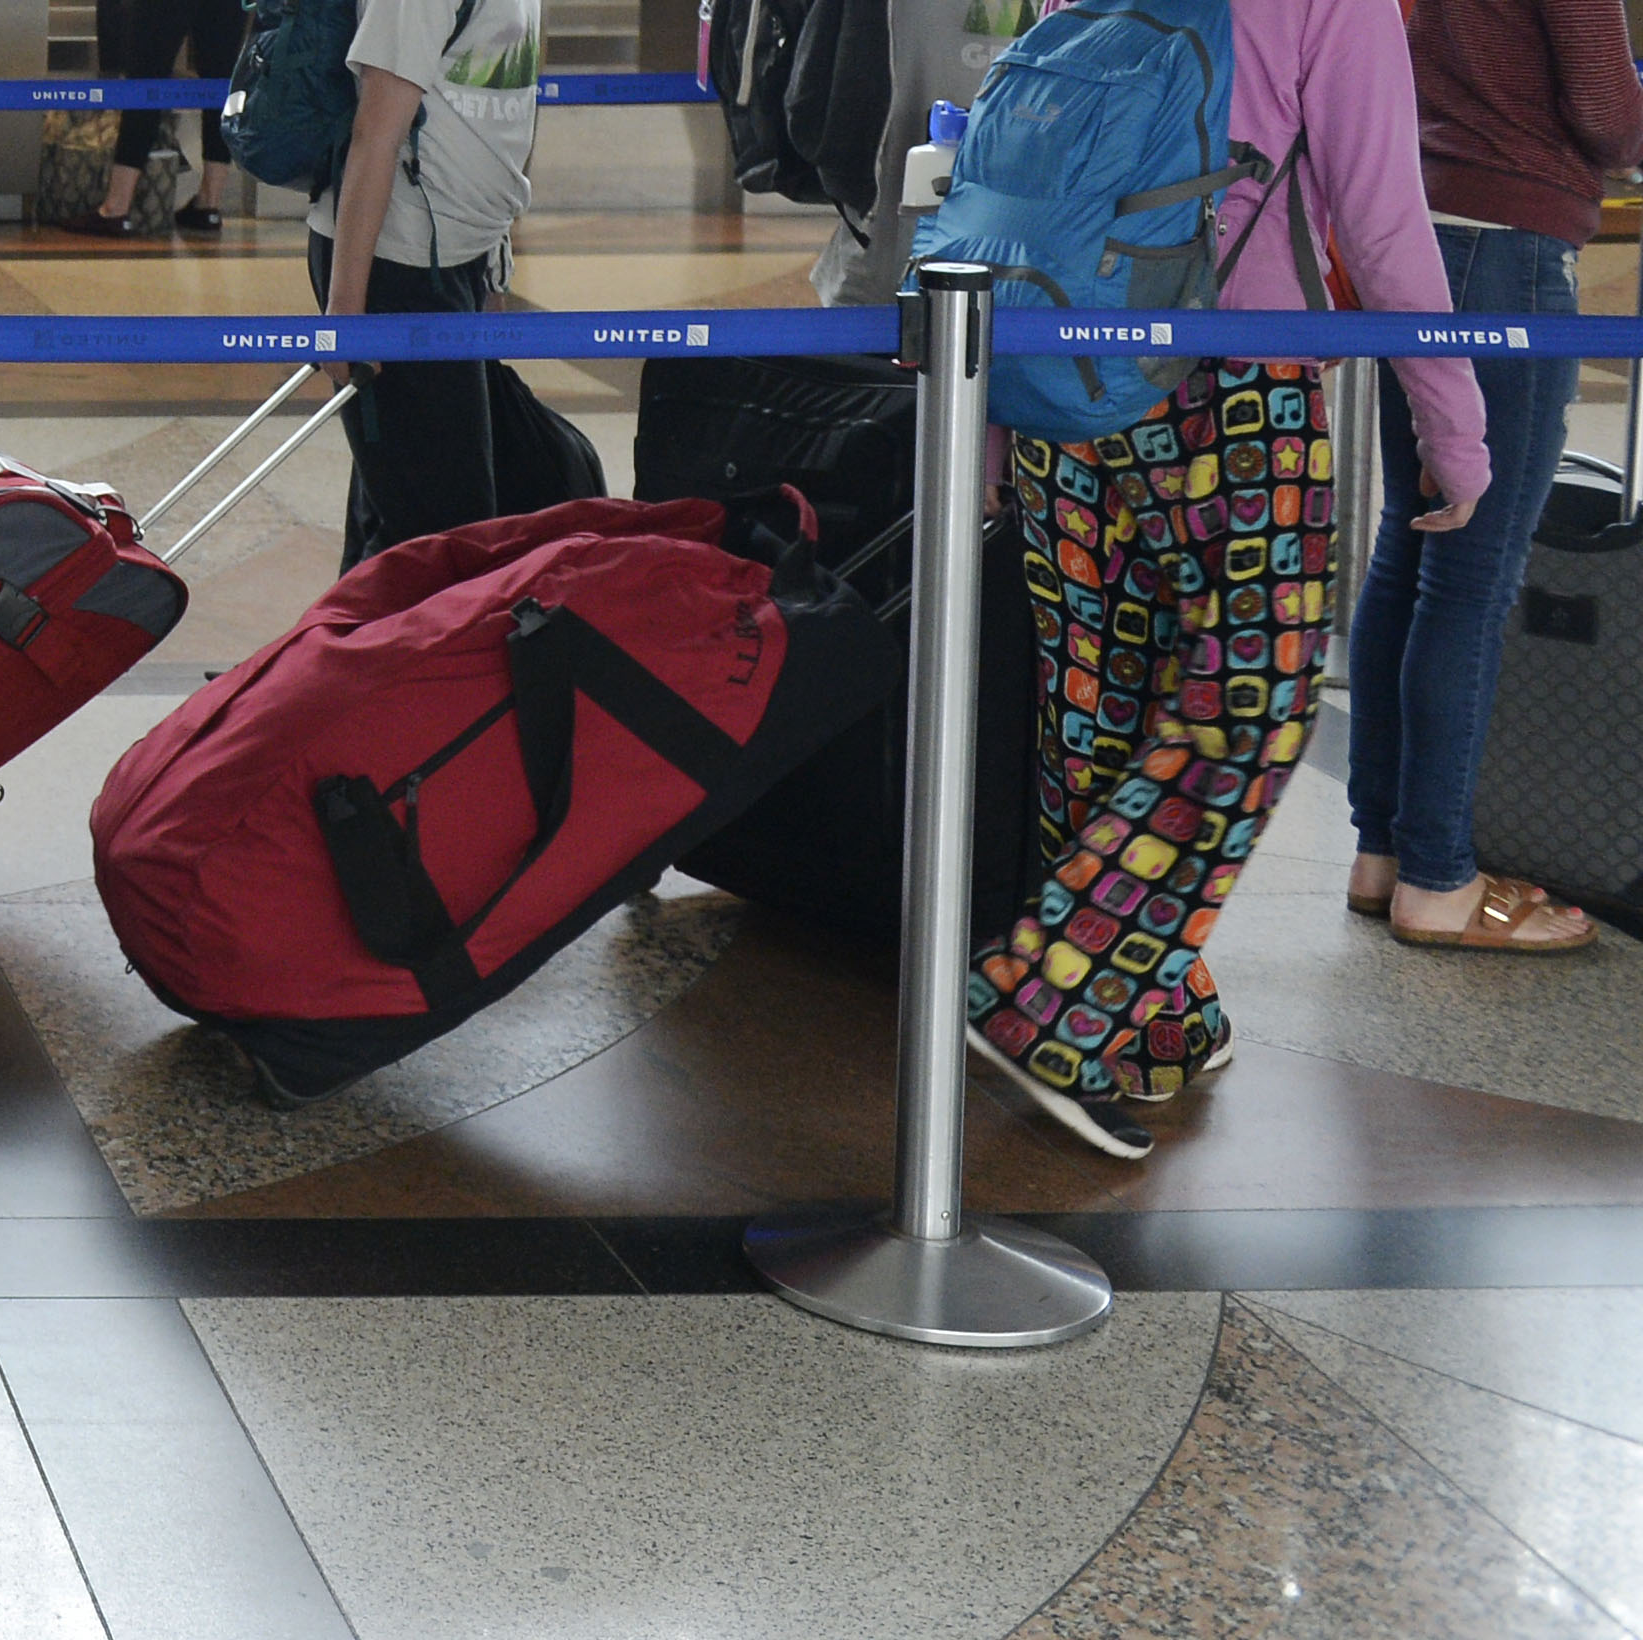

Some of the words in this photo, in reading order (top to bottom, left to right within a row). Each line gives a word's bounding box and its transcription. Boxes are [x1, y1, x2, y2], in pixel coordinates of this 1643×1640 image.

[32, 91, 87, 100] UNITED
[442, 90, 489, 119] GET
[593, 329, 682, 343] UNITED
[1059, 326, 1146, 341] UNITED
[1417, 329, 1503, 345] UNITED
[223, 334, 310, 348] UNITED
